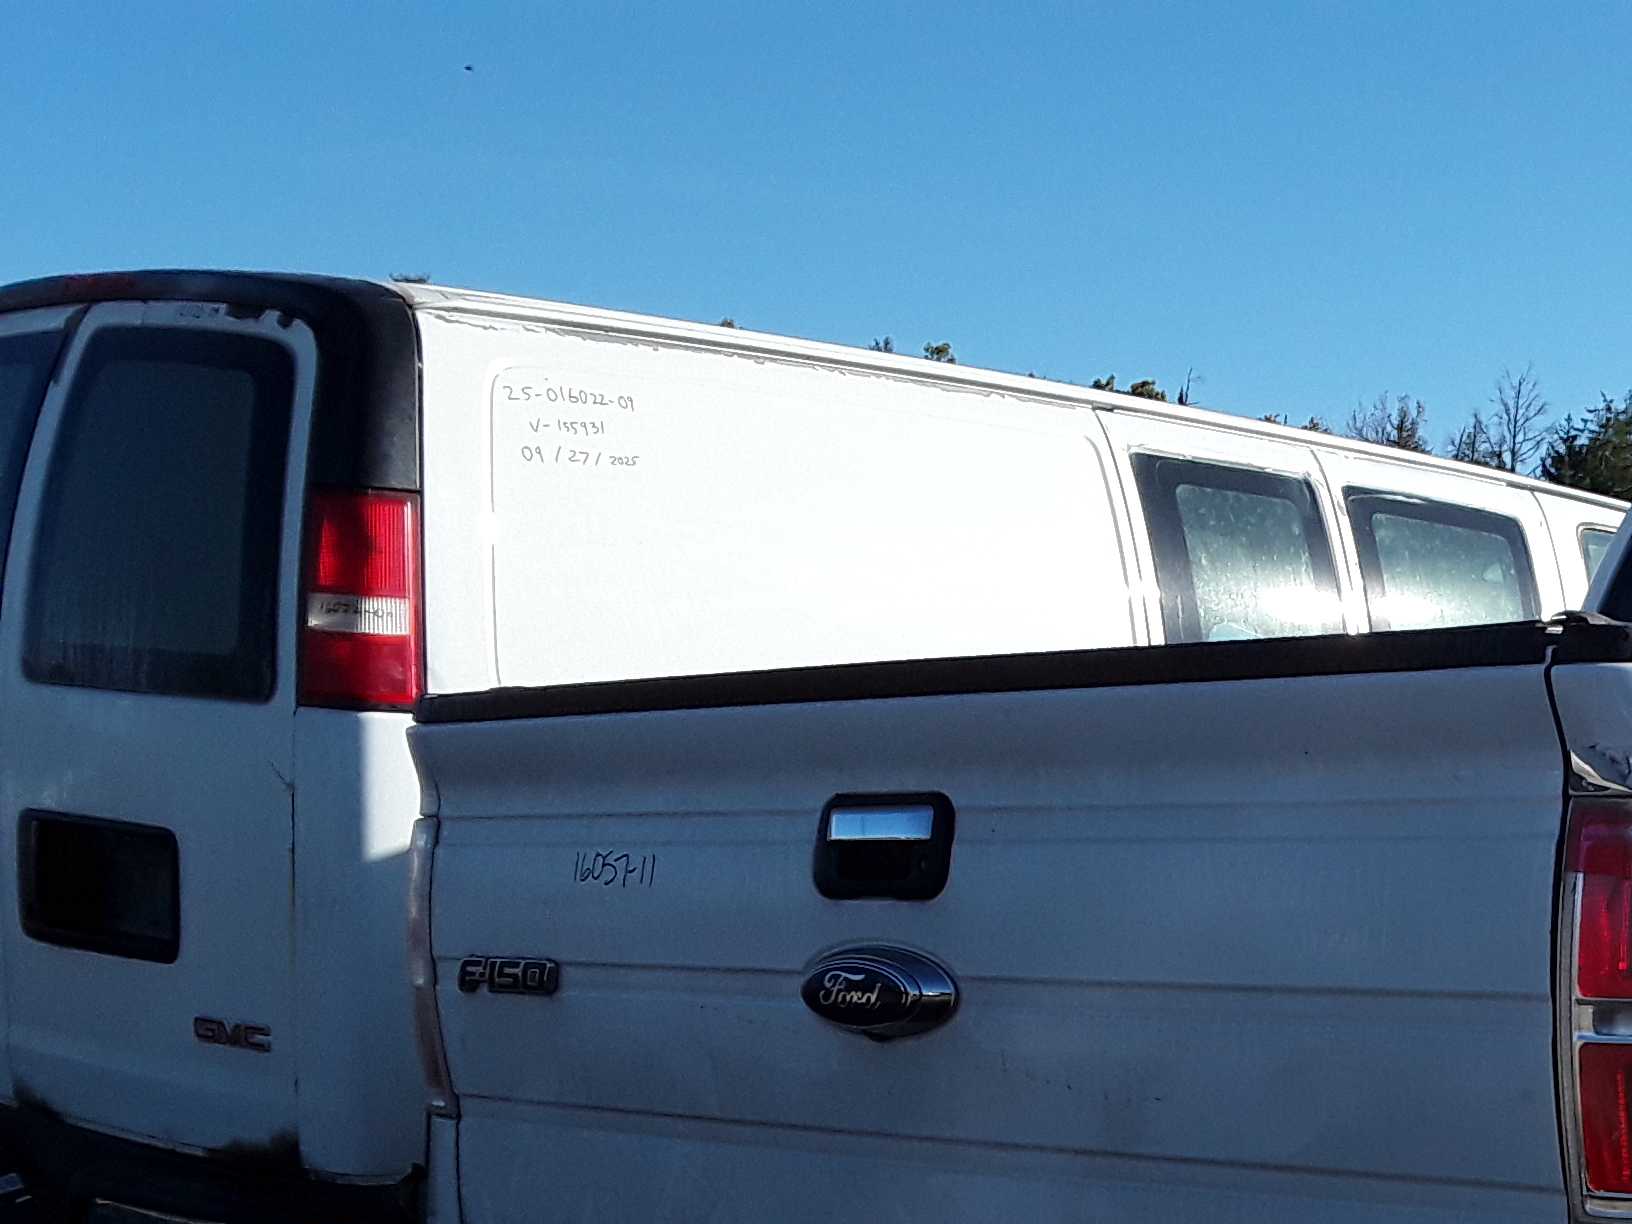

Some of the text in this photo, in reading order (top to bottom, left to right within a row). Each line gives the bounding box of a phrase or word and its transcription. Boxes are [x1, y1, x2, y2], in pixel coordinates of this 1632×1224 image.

[457, 957, 556, 994] F-150
[819, 971, 882, 1009] Ford
[194, 1017, 272, 1053] GMC
